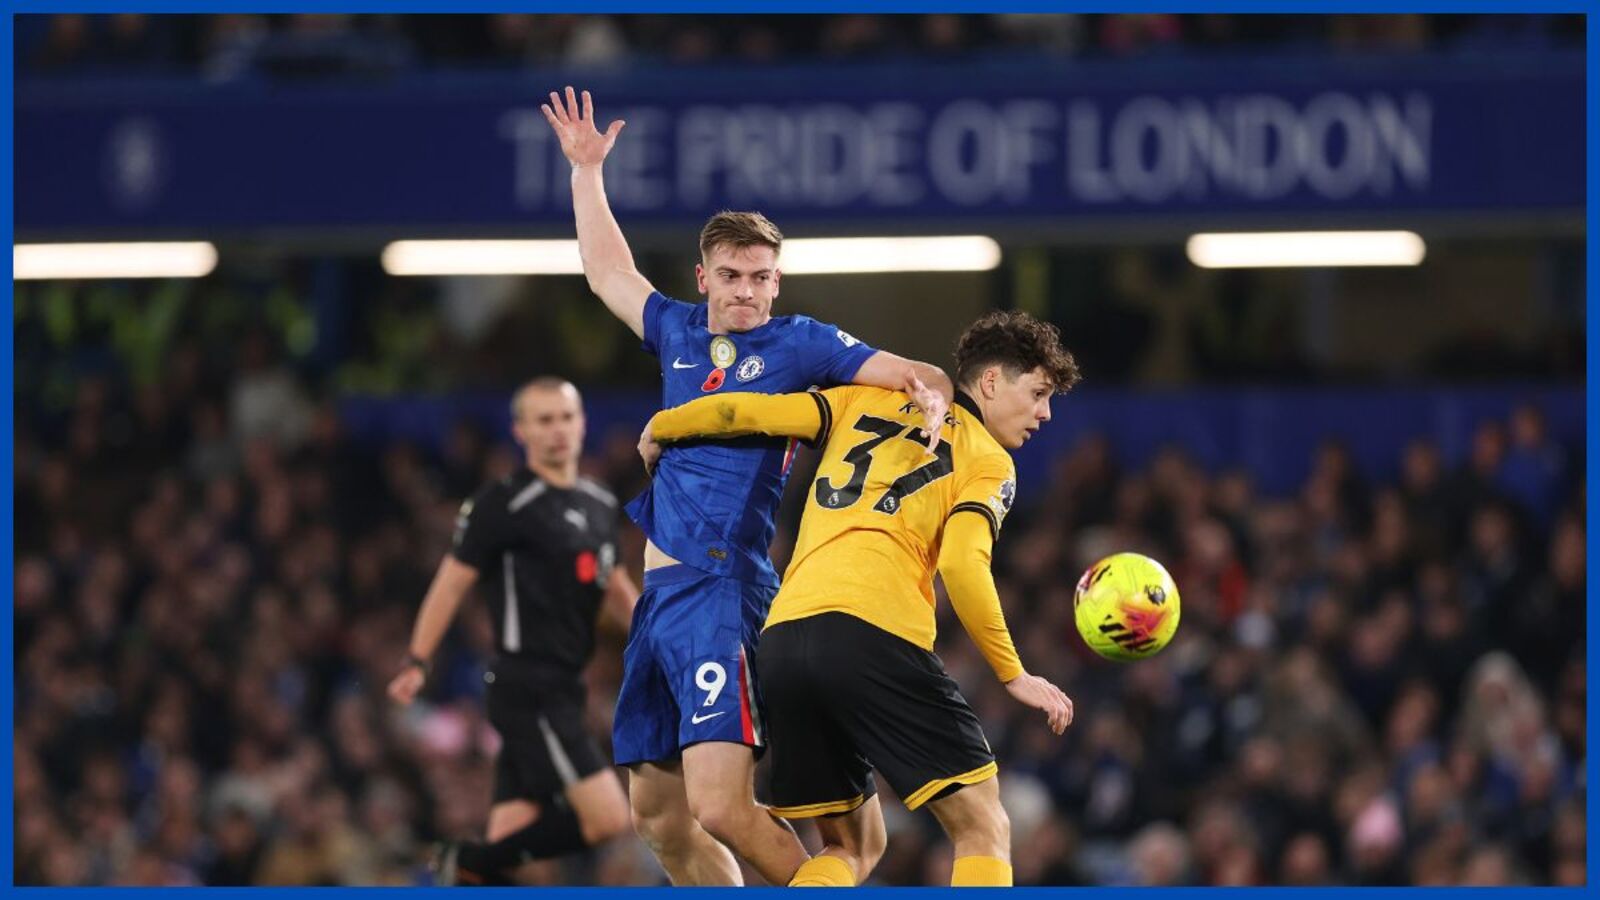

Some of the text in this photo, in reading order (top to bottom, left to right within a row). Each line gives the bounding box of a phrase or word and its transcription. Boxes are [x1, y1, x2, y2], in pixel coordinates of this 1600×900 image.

[676, 102, 924, 206] PRIDE
[930, 99, 1058, 203] OF
[1066, 93, 1432, 202] LONDON
[816, 414, 953, 515] 37
[695, 661, 726, 707] 9
